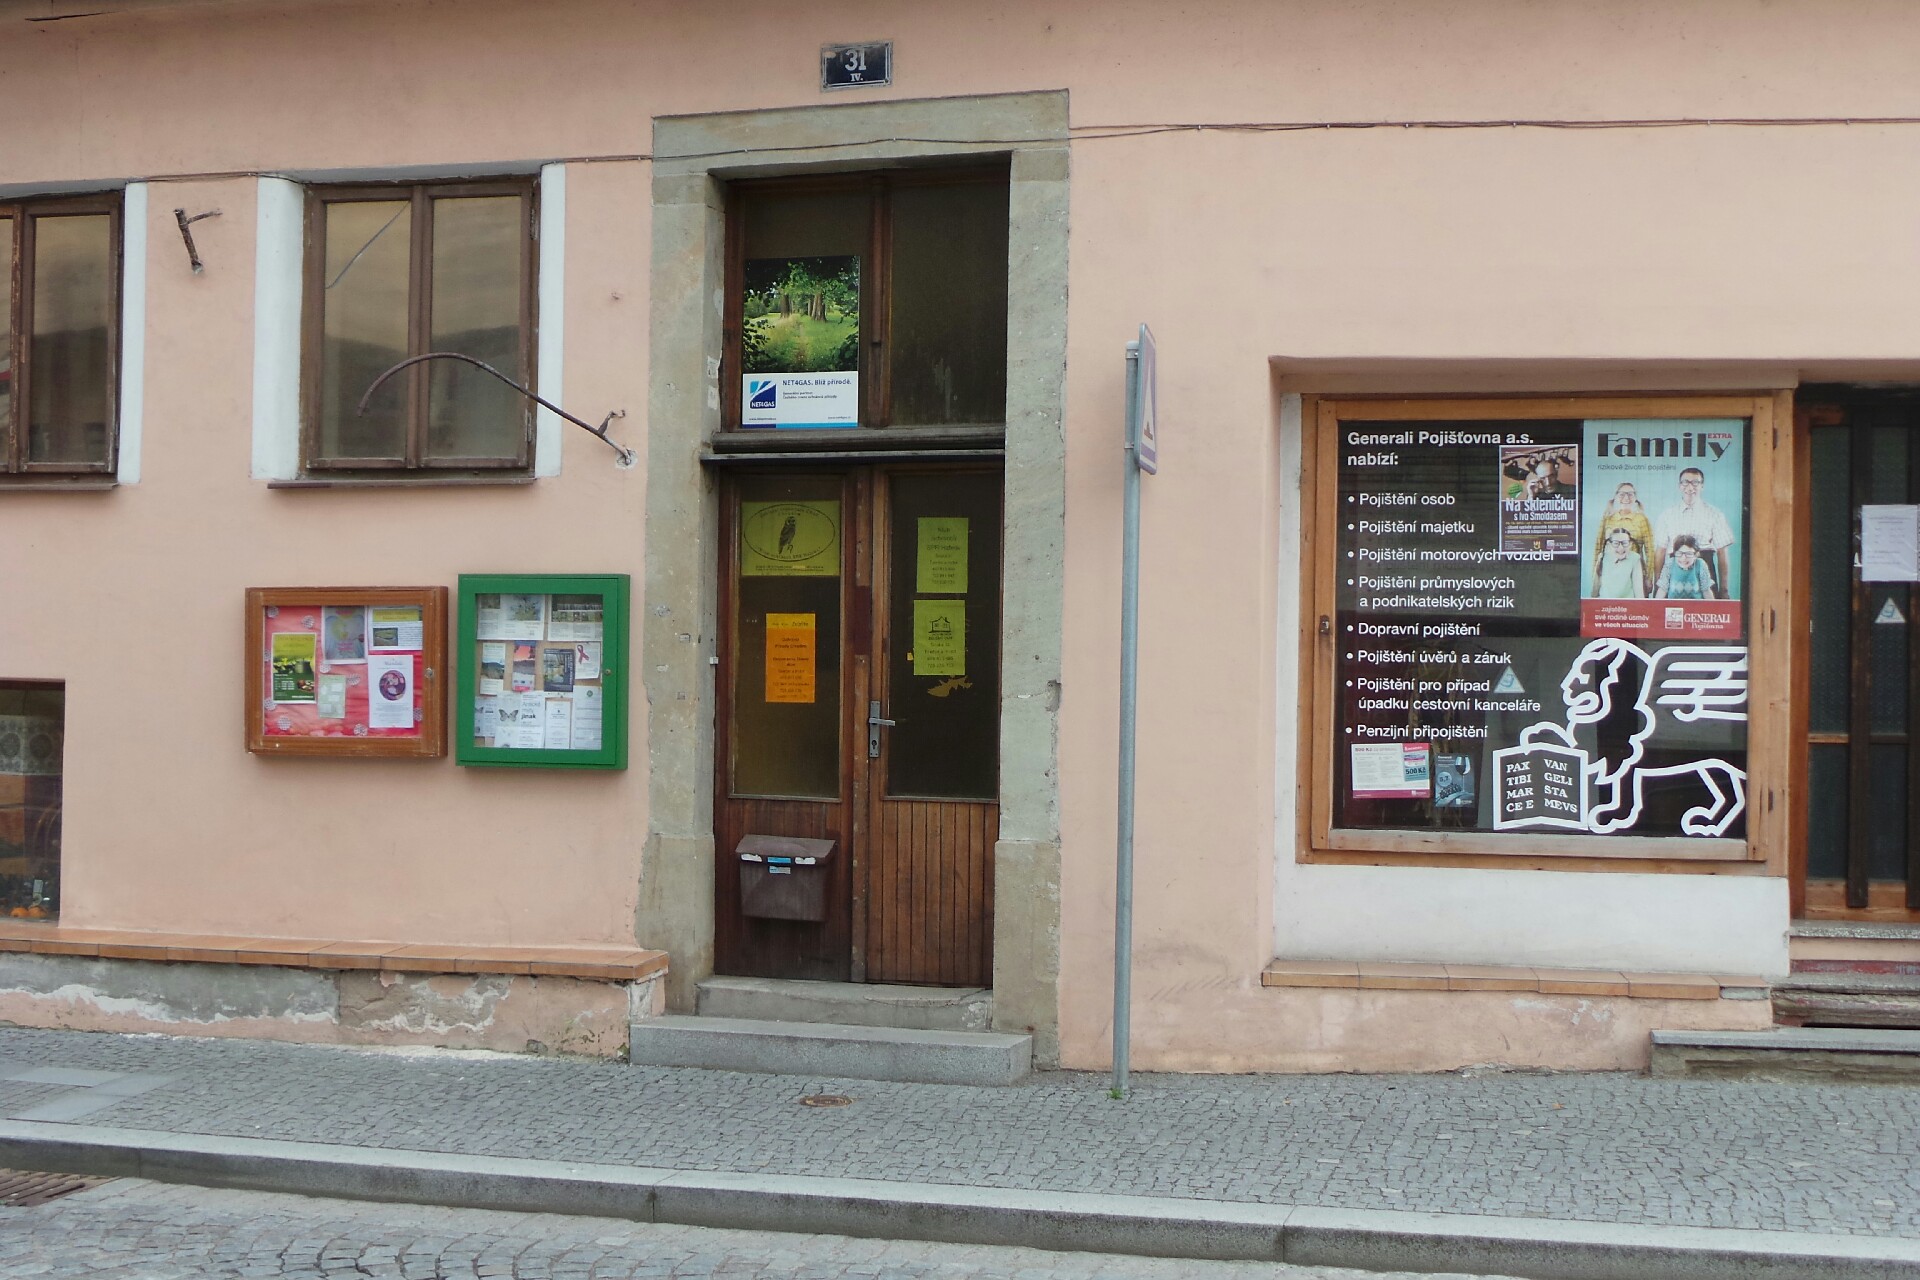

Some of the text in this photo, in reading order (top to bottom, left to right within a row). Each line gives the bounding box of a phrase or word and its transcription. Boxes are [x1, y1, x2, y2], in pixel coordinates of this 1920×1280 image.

[845, 48, 867, 71] 31
[850, 73, 864, 81] IV.
[1348, 430, 1534, 447] Generali Pojišťovna a.s.
[1598, 432, 1730, 462] Family
[1348, 452, 1398, 466] nabízí:
[1359, 492, 1456, 508] Pojištění osob
[1505, 494, 1574, 511] Na skleničku
[1359, 520, 1474, 535] Pojištění majetku
[1359, 548, 1554, 564] Pojištění motorových vozidel
[1359, 575, 1515, 592] Pojištění průmyslových
[1359, 595, 1514, 611] a podnikatelských rizik
[1684, 614, 1730, 623] GENERALI
[1358, 622, 1480, 638] Dopravní pojištění
[1358, 650, 1512, 664] Pojištění úvěrů a záruk
[1358, 678, 1490, 694] Pojištění pro případ
[1358, 697, 1540, 712] úpadku cestovní kanceláře
[1357, 724, 1488, 740] Penzijní připojištění
[1506, 761, 1530, 773] PAX
[1544, 759, 1568, 772] VAN
[1506, 774, 1532, 785] TIBI
[1544, 772, 1573, 786] GELI
[1506, 787, 1534, 799] MAR
[1544, 786, 1568, 798] STA
[1506, 800, 1534, 812] CE E
[1544, 800, 1578, 813] MEVS
